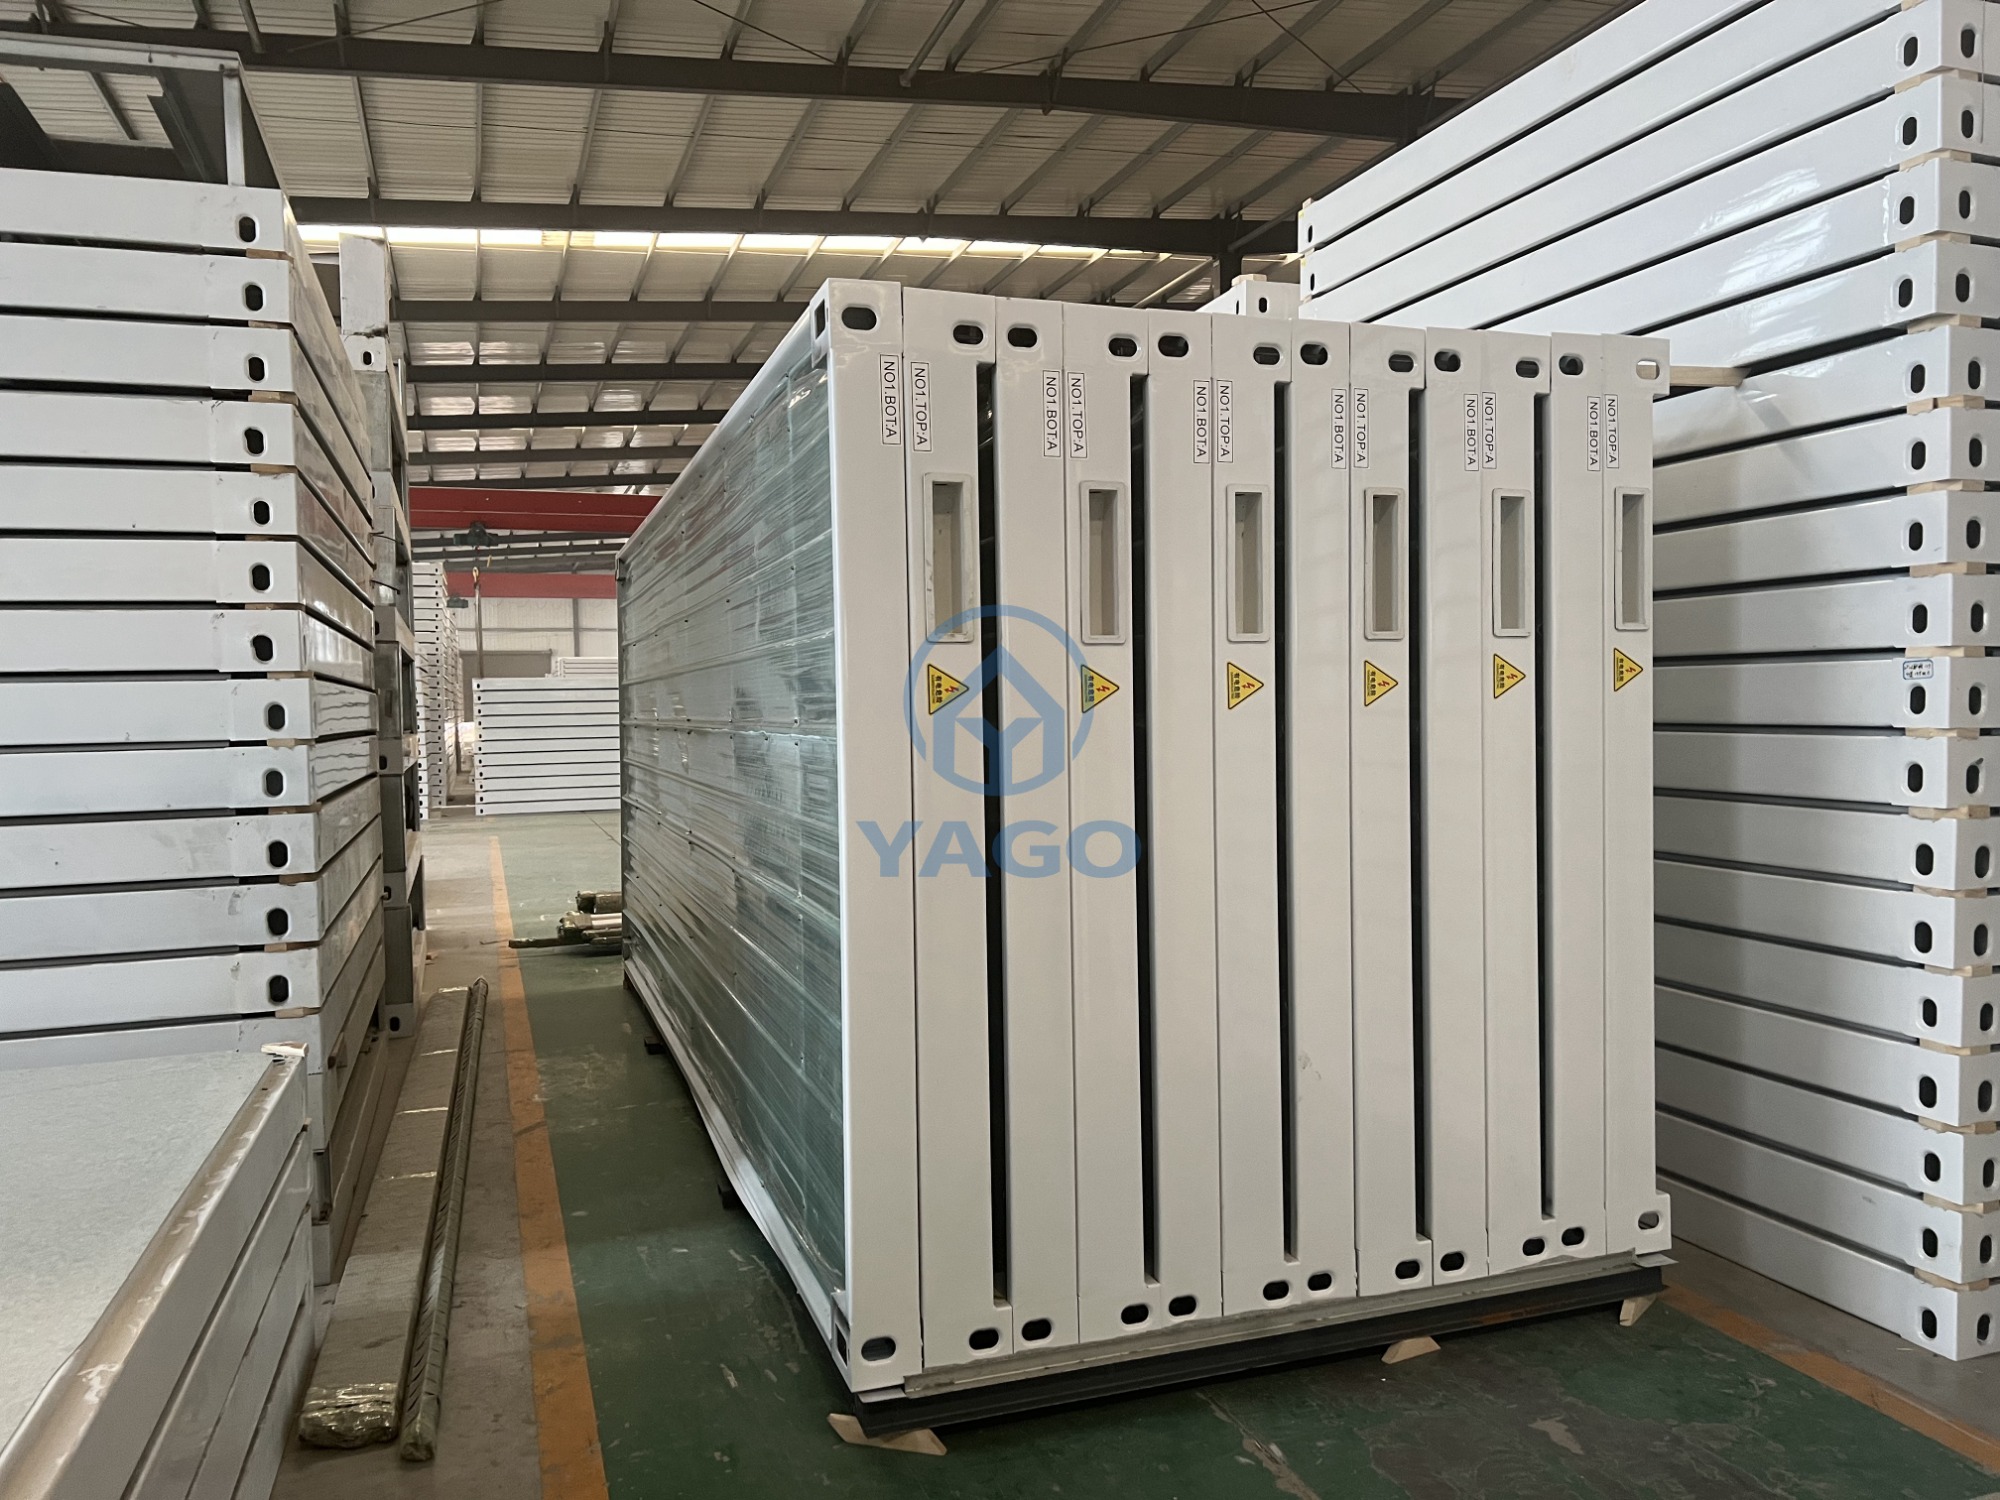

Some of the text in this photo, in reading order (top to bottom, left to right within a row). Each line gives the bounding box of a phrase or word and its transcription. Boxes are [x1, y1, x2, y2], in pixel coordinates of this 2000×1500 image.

[884, 361, 897, 437] NO1.BOT:A
[914, 368, 928, 445] NO1.TOP:A
[1046, 377, 1057, 450] NO1.BOT:A
[1071, 378, 1083, 452] NO1.TOP:A
[1196, 386, 1207, 457] NO1.BOT:A
[1220, 385, 1230, 457] NO1.TOP:A
[1334, 394, 1344, 462] NO1.BOT:A
[1356, 393, 1366, 462] NO1.TOP:A
[1467, 399, 1476, 465] NO1.BOT:A
[1485, 397, 1494, 463] NO1.TOP:A
[1589, 401, 1598, 465] NO1.BOT:A
[1608, 398, 1617, 463] NO1.TOP:A
